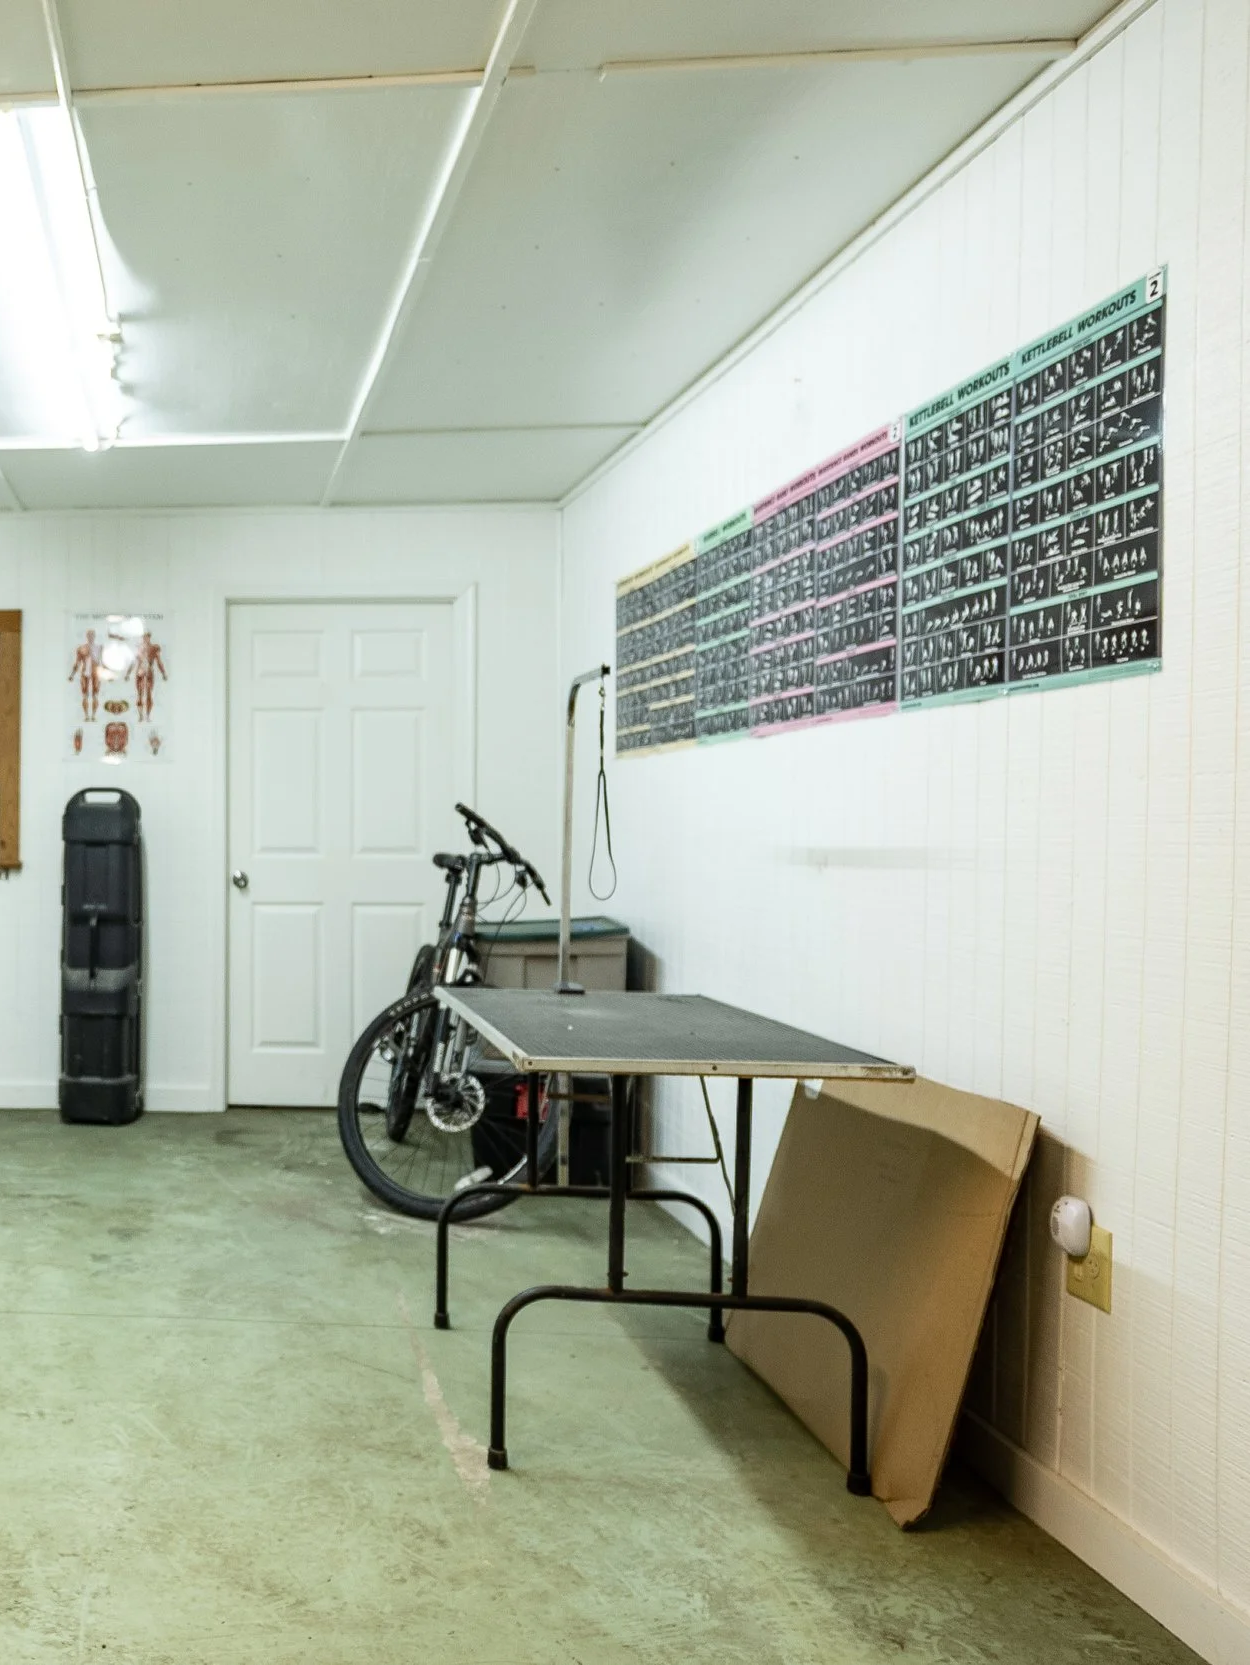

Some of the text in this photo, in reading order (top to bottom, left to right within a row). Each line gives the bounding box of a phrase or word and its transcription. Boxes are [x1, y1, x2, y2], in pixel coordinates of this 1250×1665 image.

[1150, 280, 1158, 297] 2
[1021, 290, 1137, 365] KETTLEBELL WORKOUTS
[910, 362, 1010, 426] KETTLEBELL WORKOUTS
